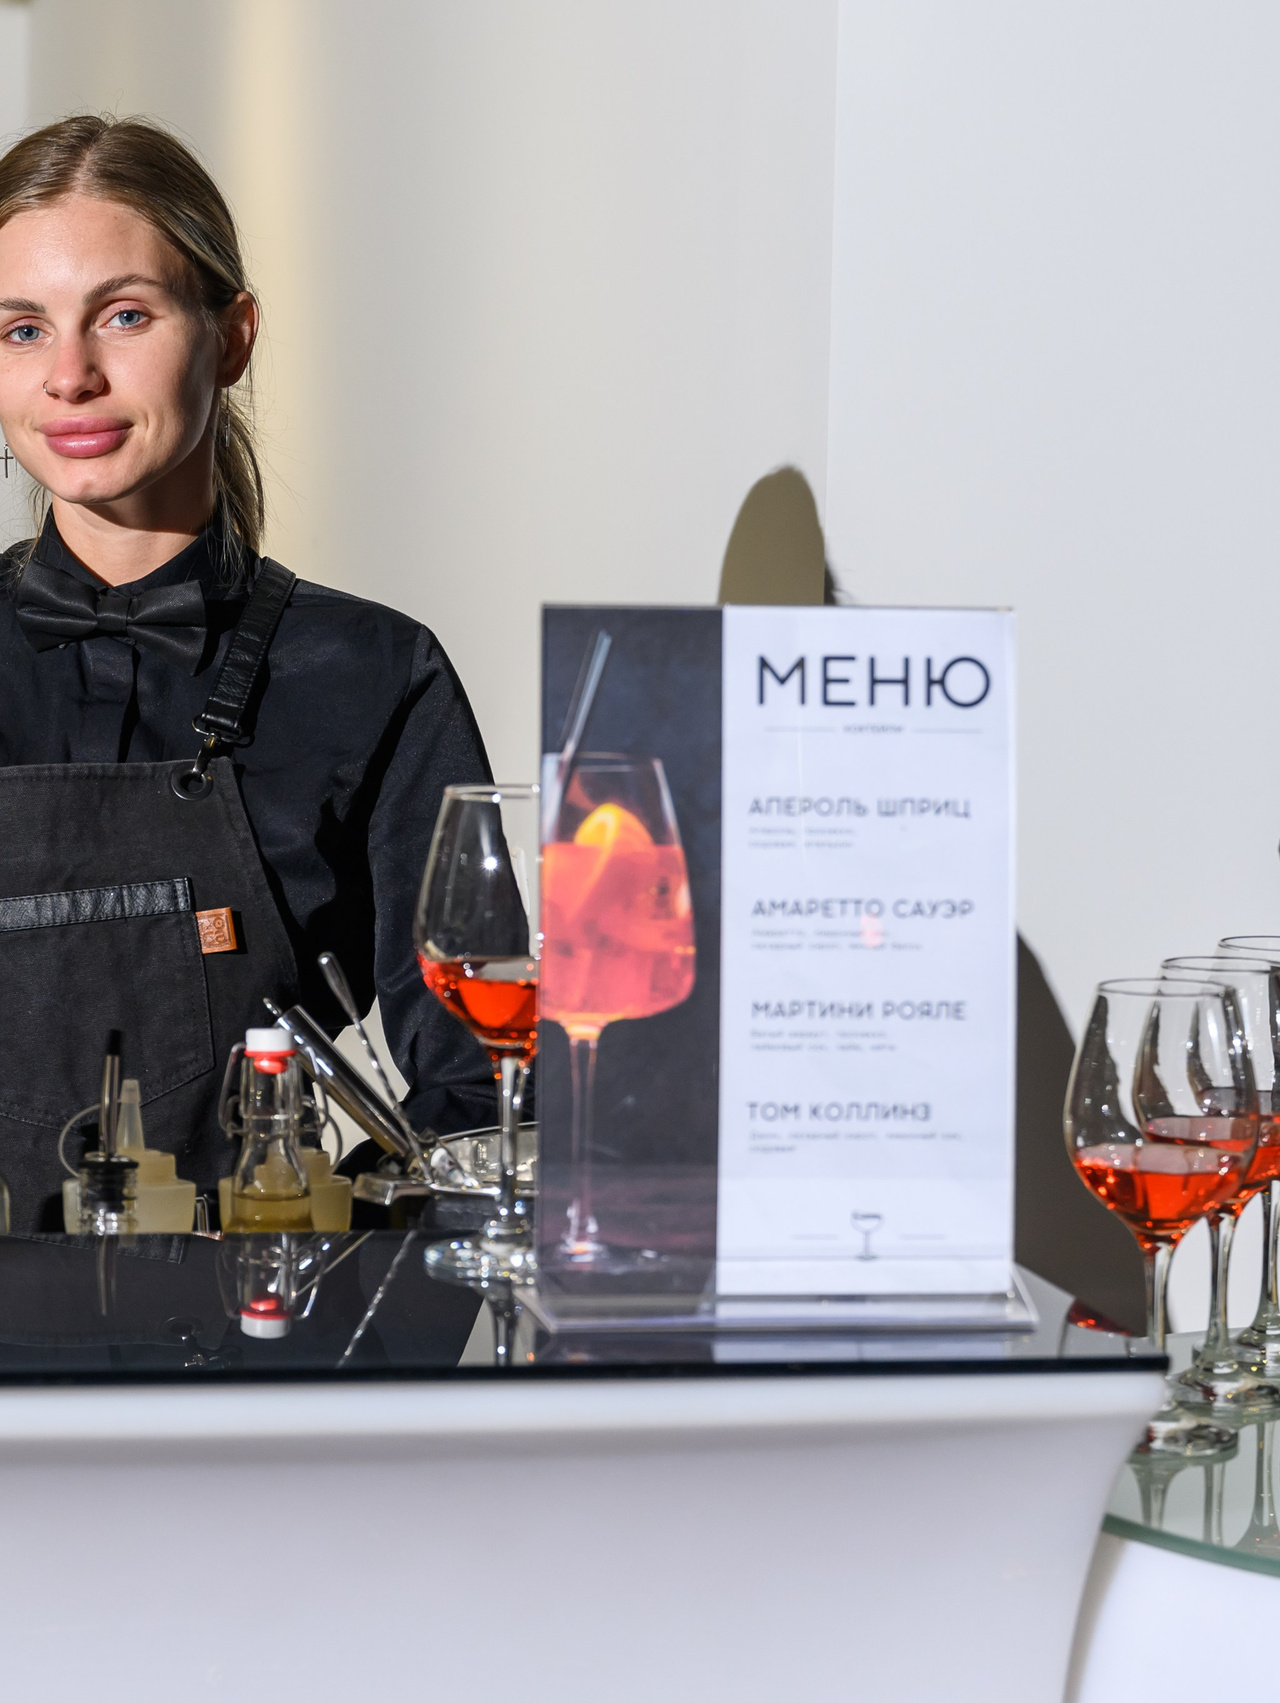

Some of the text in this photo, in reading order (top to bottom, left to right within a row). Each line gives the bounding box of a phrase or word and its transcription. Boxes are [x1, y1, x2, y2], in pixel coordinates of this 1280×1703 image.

[756, 655, 992, 709] МЕНЮ
[748, 796, 971, 820] АПЕРОЛЬ ШПРИЦ
[750, 897, 975, 919] АМАРЕТТО САУЭР
[751, 1000, 967, 1021] МАРТИНИ РОЯЛЕ
[746, 1101, 932, 1122] ТОМ КОЛЛИНЗ
